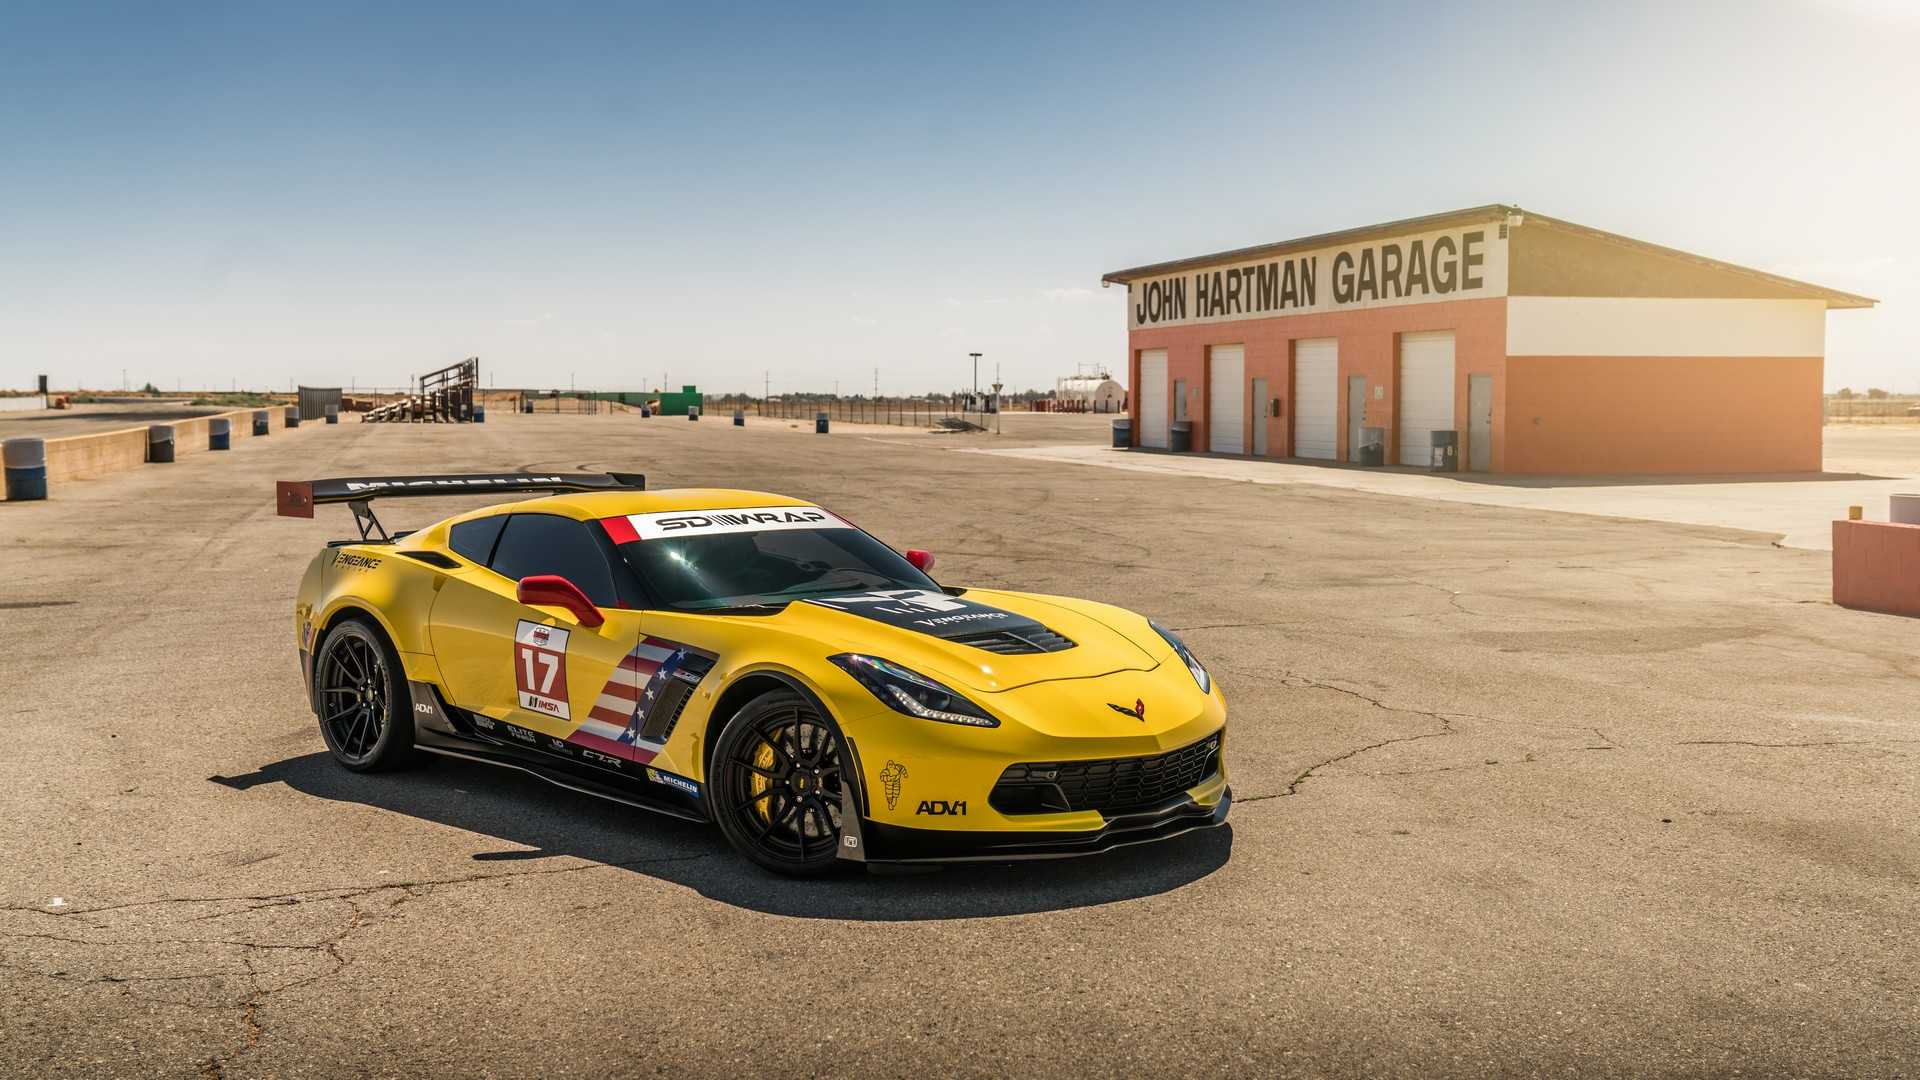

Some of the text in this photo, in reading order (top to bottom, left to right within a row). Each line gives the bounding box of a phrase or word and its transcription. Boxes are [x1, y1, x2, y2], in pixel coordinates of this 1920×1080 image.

[1136, 231, 1485, 325] JOHN HARTMAN GARAGE
[521, 647, 559, 694] 17
[538, 700, 560, 713] IMSA
[663, 775, 698, 793] MICHELIN
